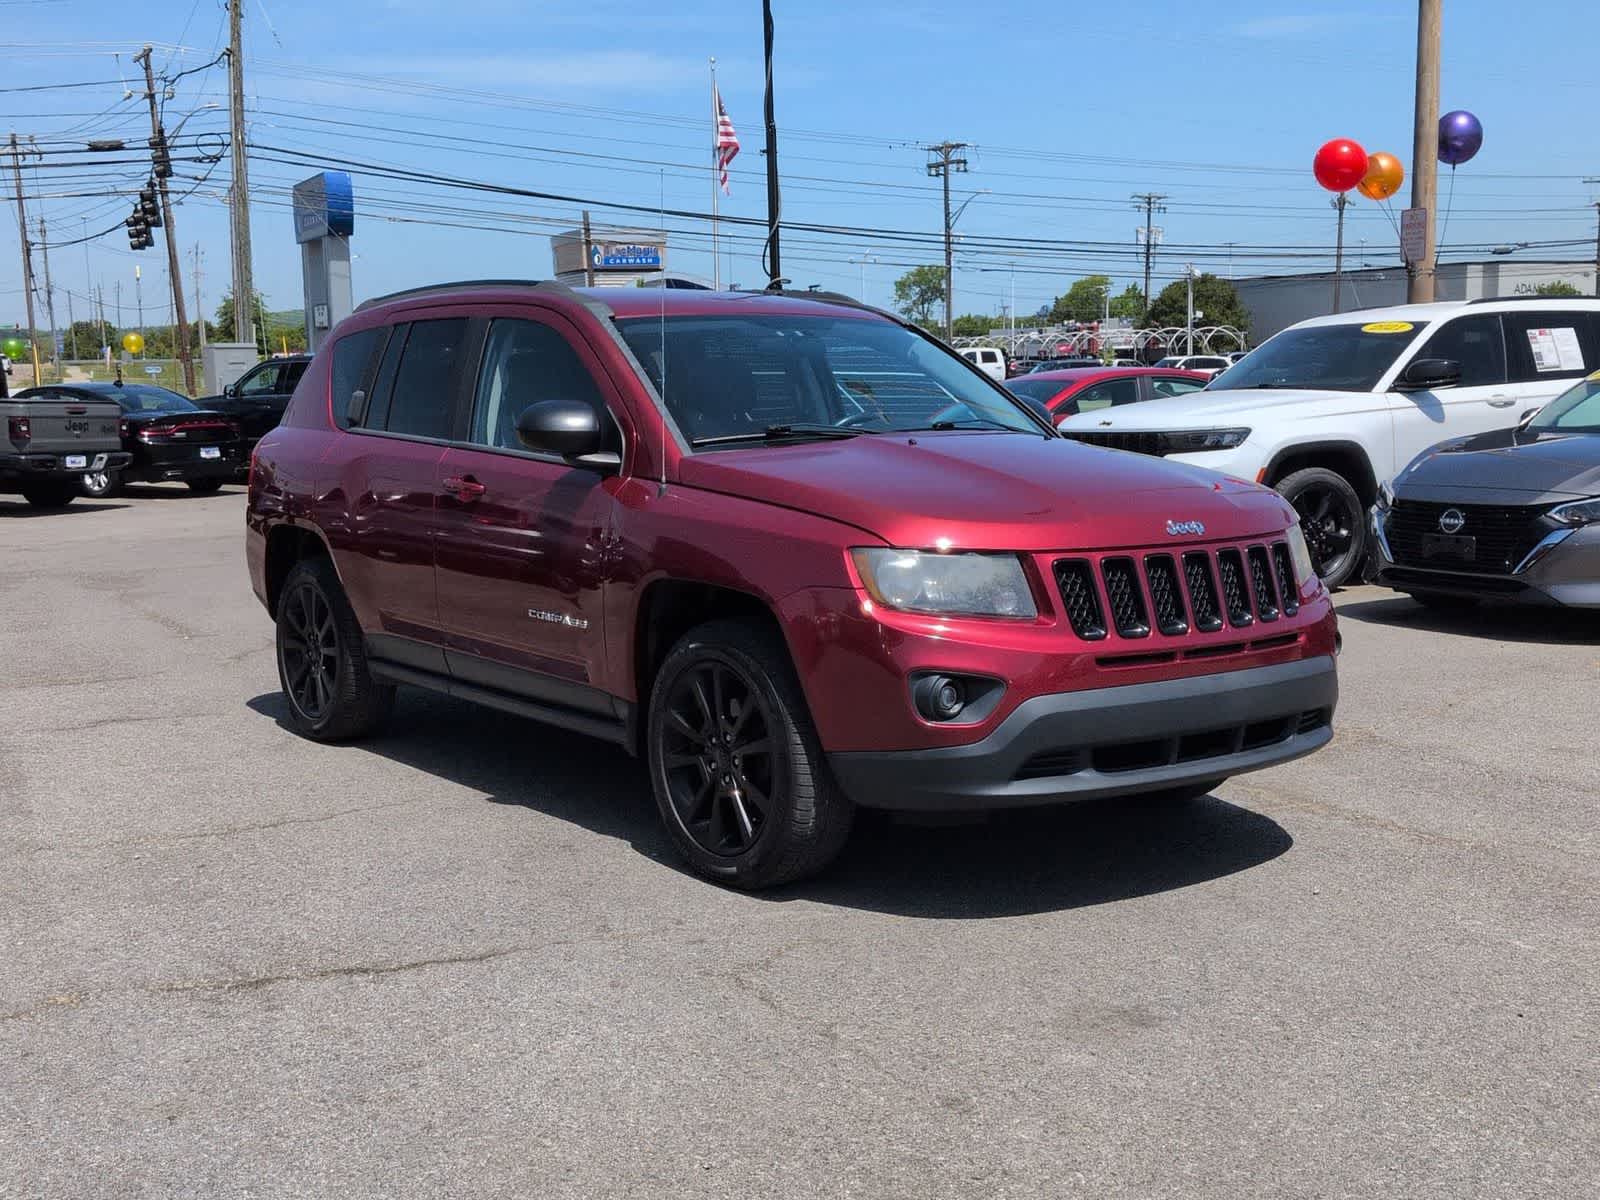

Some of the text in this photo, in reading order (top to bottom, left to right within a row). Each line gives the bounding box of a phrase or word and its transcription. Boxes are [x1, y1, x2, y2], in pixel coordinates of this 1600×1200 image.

[65, 420, 89, 432] Jeep
[1166, 520, 1204, 536] Jeep
[528, 609, 588, 629] COMPASS
